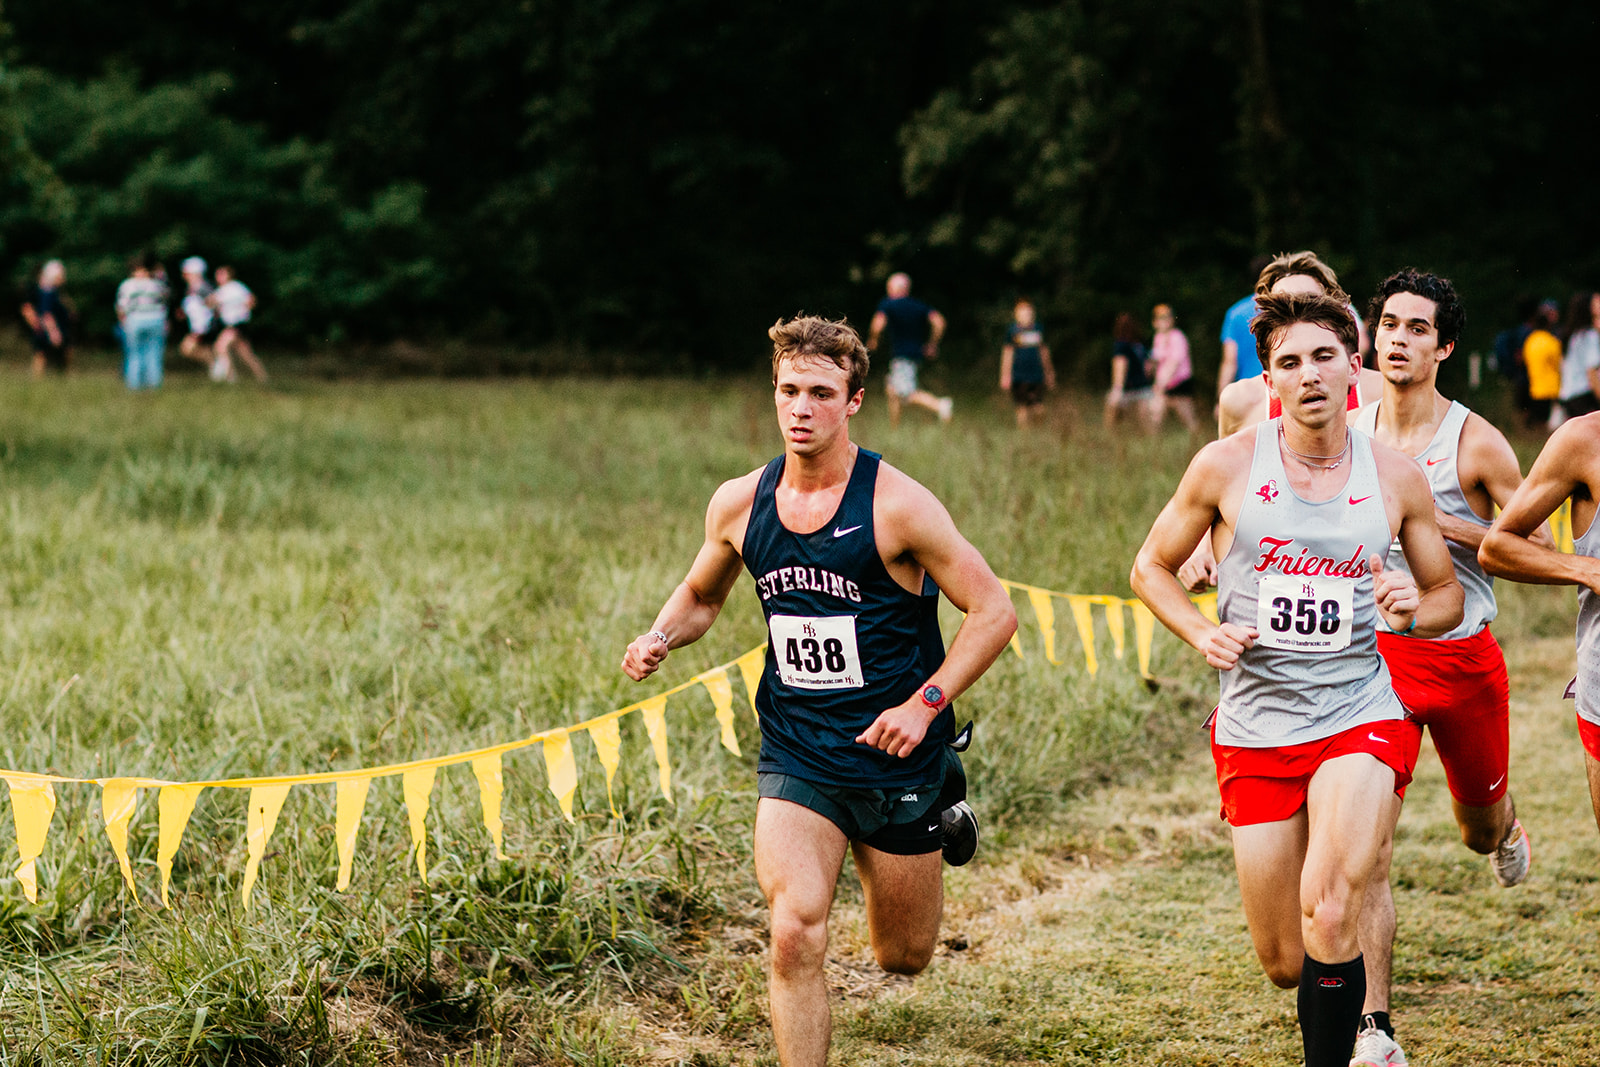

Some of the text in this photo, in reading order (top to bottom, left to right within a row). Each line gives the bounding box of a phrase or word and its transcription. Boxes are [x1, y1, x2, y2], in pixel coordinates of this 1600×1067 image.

[1253, 535, 1369, 579] Friends
[757, 566, 862, 603] STERLING
[1270, 596, 1341, 635] 358
[786, 638, 847, 673] 438
